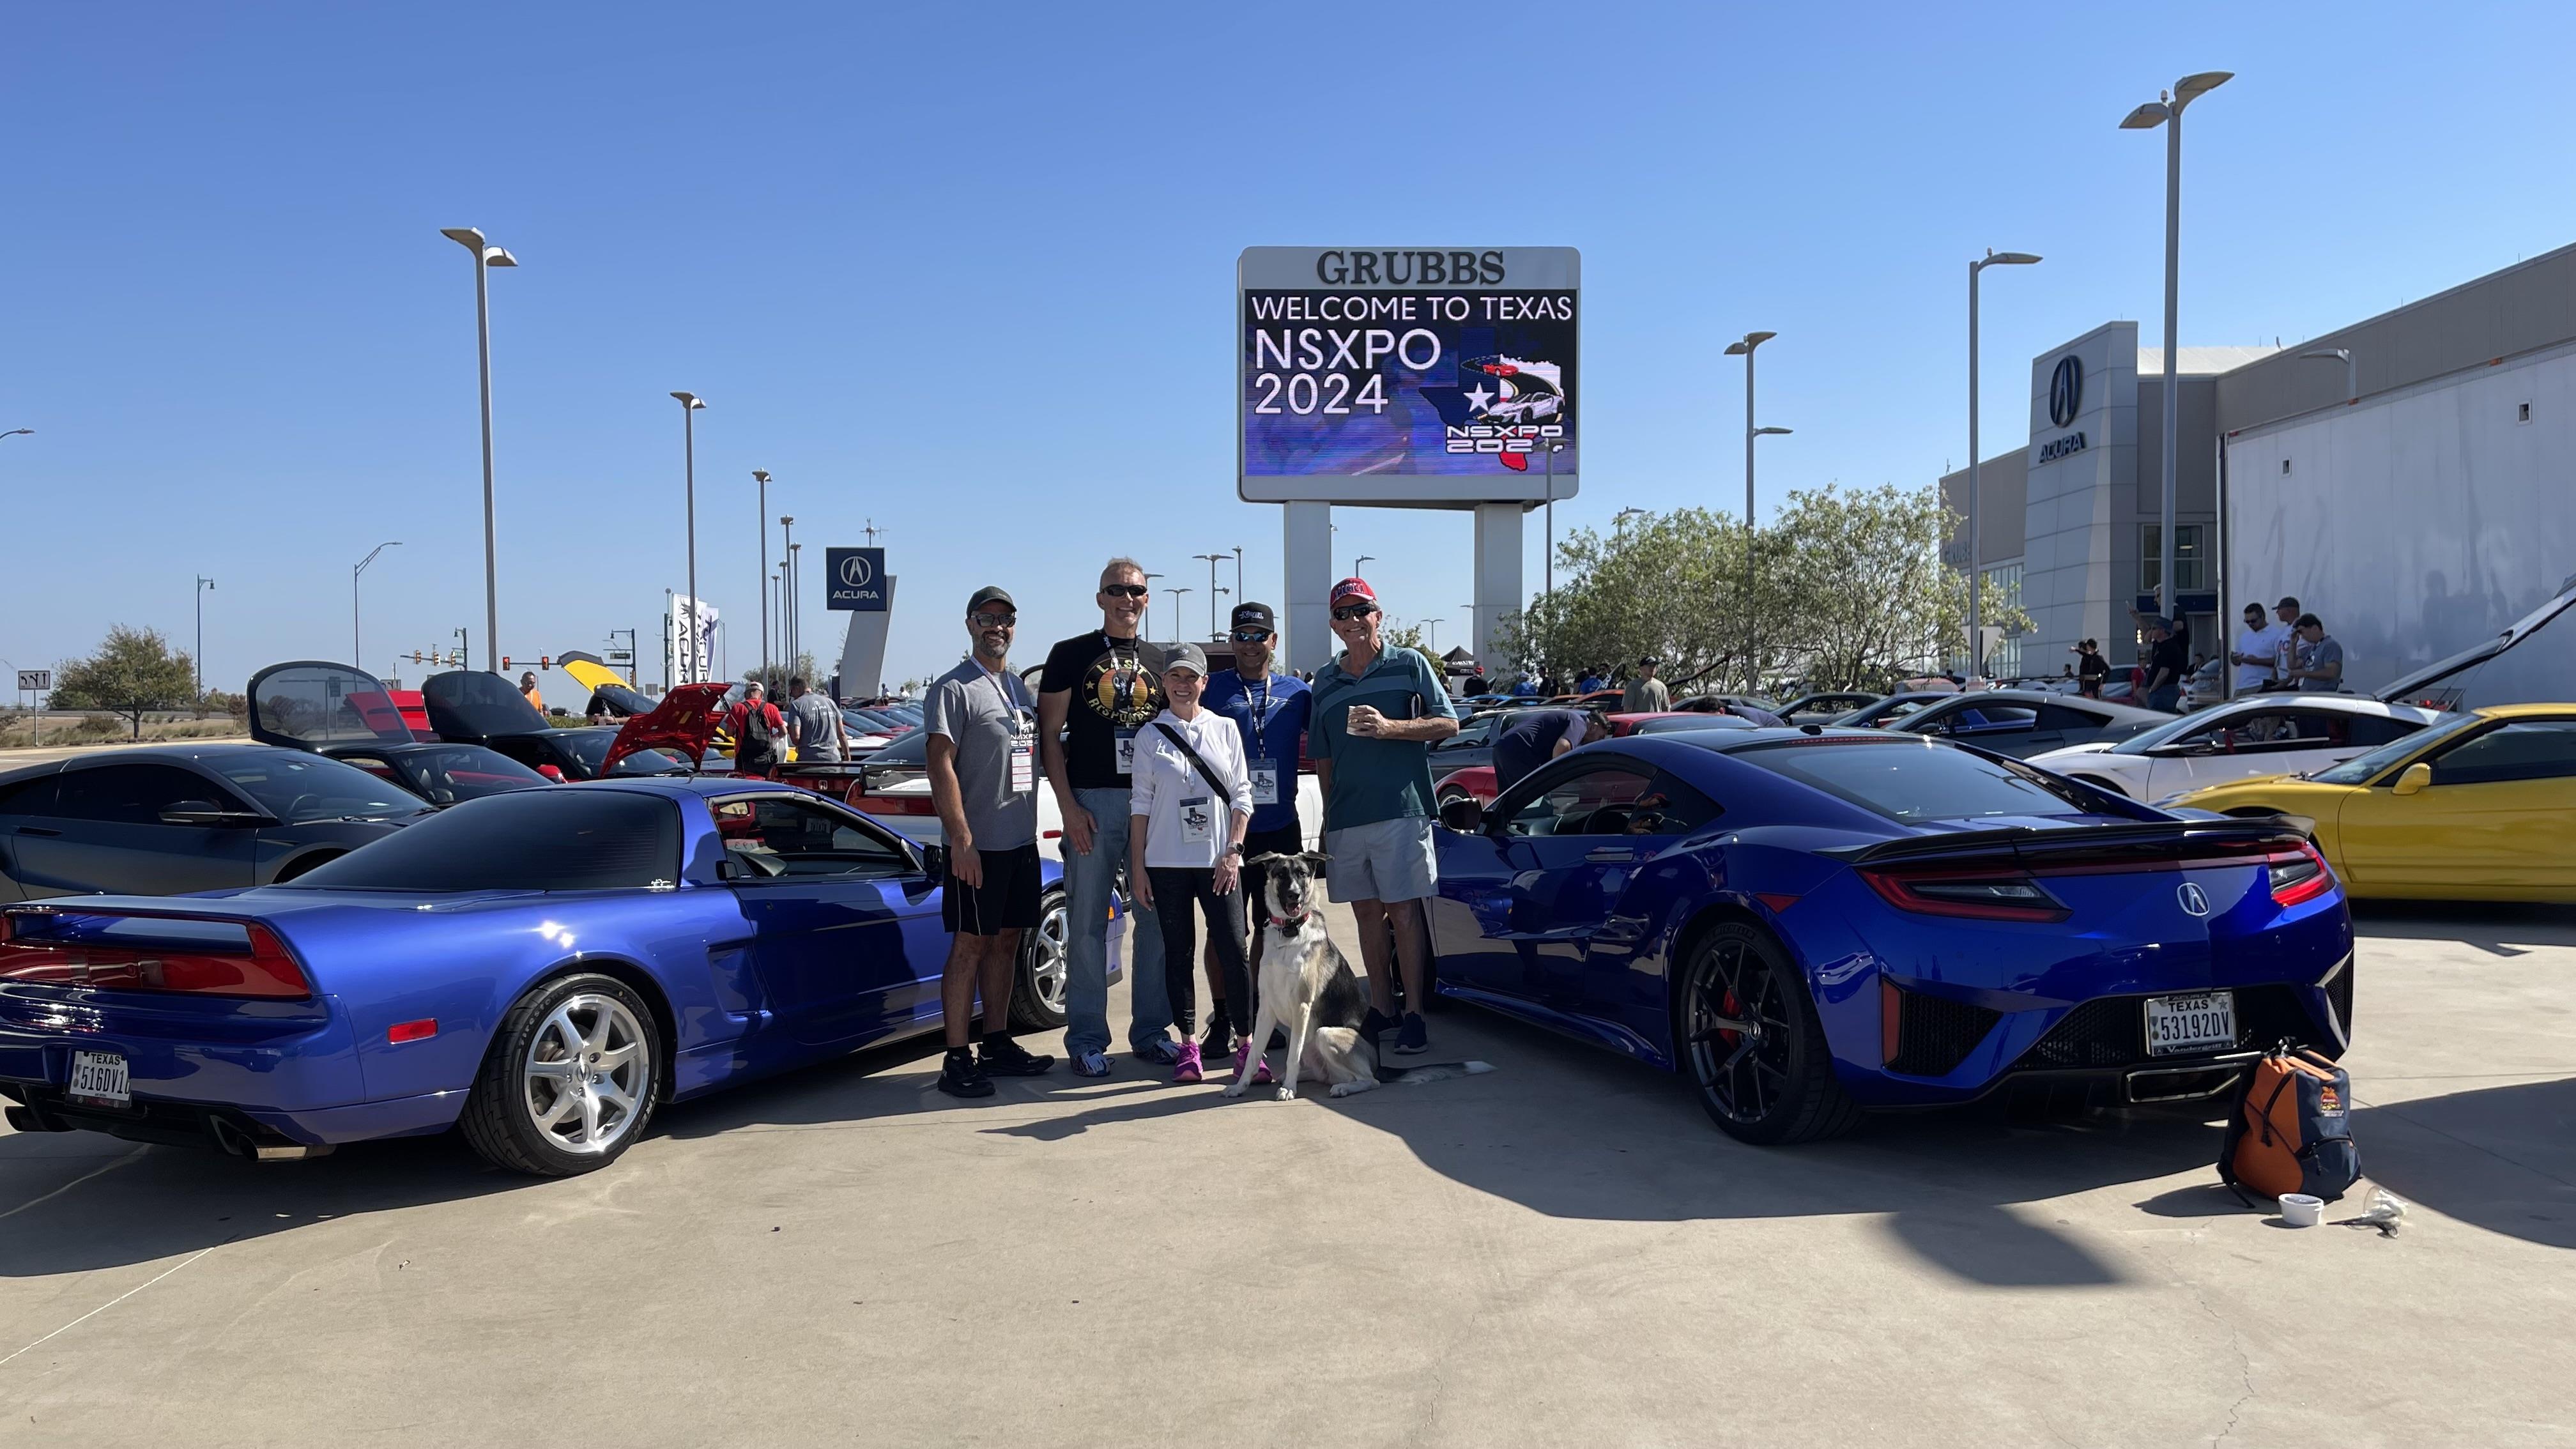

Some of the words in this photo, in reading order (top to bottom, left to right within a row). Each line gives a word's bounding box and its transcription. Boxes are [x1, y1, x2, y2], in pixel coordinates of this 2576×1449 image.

[1317, 250, 1505, 286] GRUBBS
[1252, 296, 1416, 321] WELCOME
[1426, 296, 1471, 321] TO
[1480, 296, 1573, 321] TEXAS
[1254, 328, 1442, 371] NSXPO
[1254, 372, 1389, 415] 2024
[1446, 425, 1564, 438] NSXPO
[2038, 431, 2086, 464] ACURA
[832, 590, 879, 599] ACURA
[2168, 999, 2209, 1013] TEXAS
[2161, 1011, 2229, 1041] 53192DV
[91, 1054, 121, 1066] TEXAS
